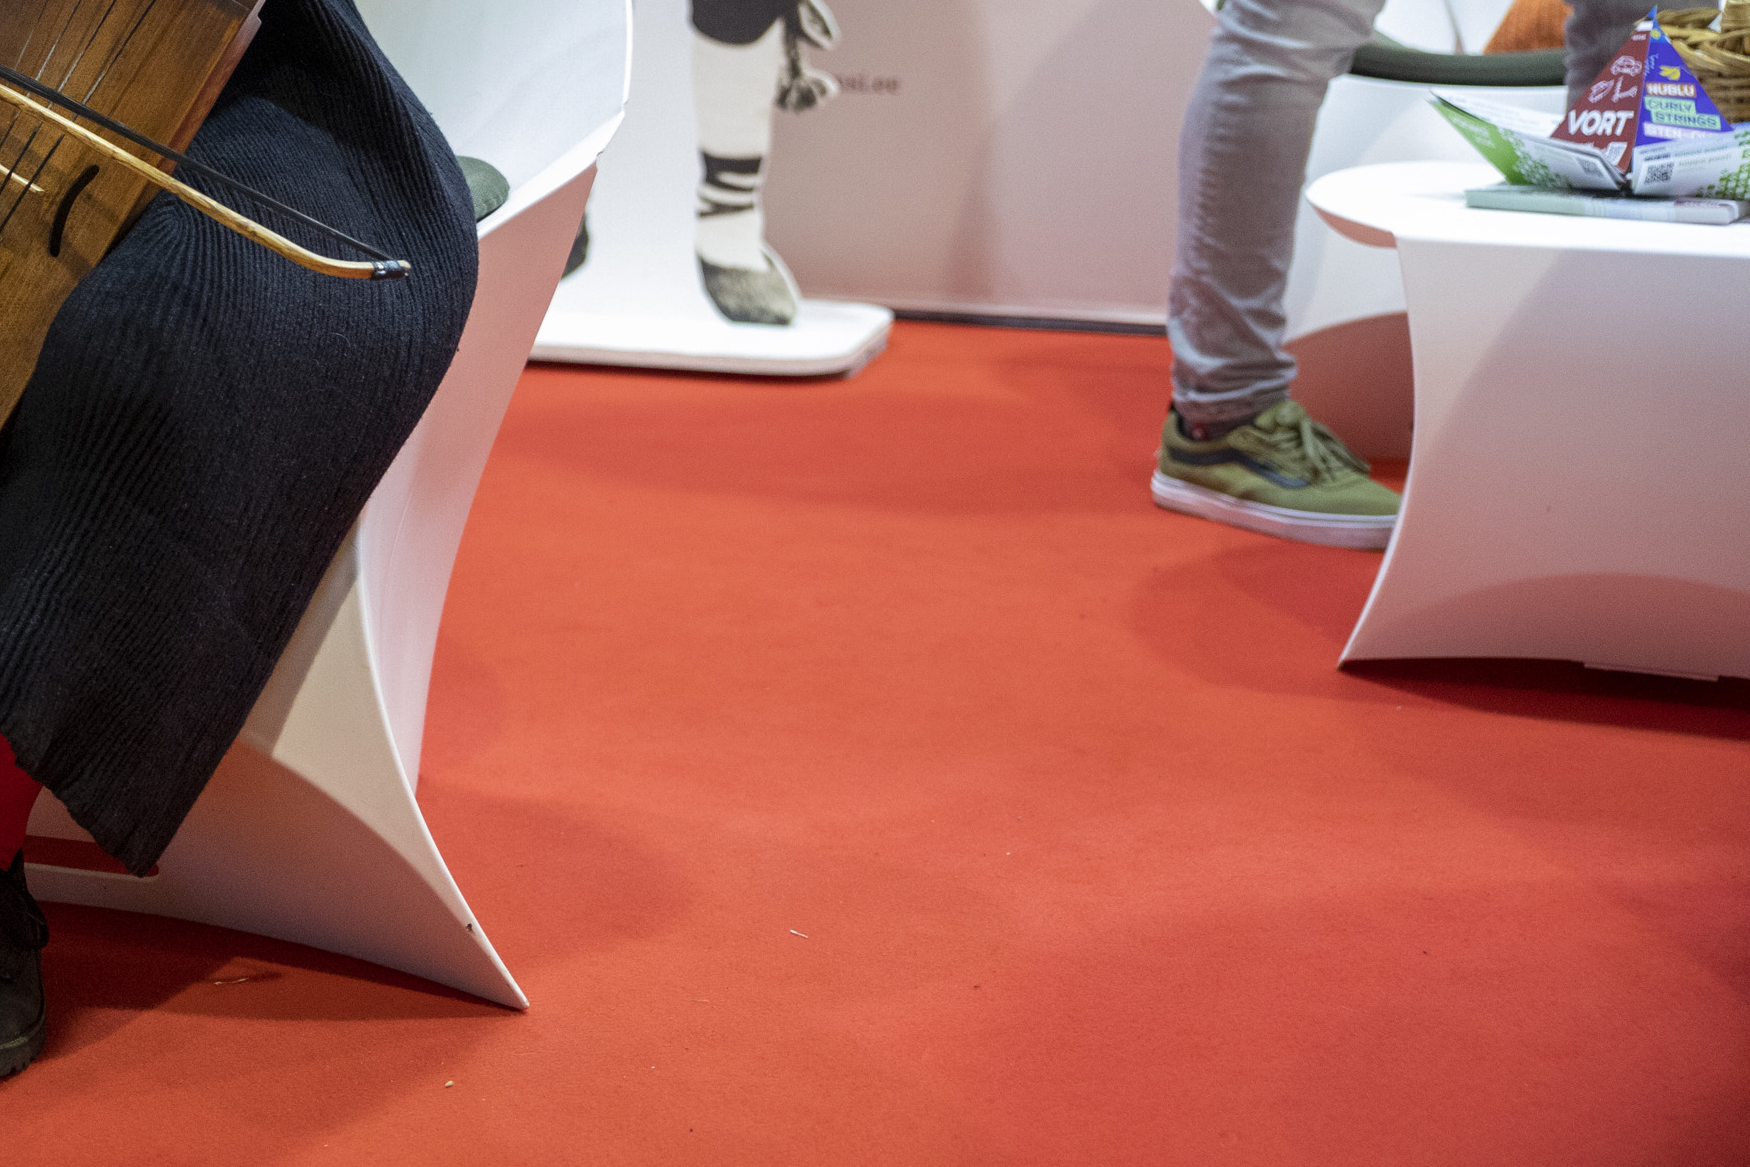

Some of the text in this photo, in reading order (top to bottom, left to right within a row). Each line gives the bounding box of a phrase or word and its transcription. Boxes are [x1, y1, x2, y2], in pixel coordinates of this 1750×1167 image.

[1646, 83, 1695, 97] NUBLU
[1649, 99, 1692, 113] CURLY
[1567, 109, 1635, 137] VORT
[1655, 112, 1718, 127] STRINGS
